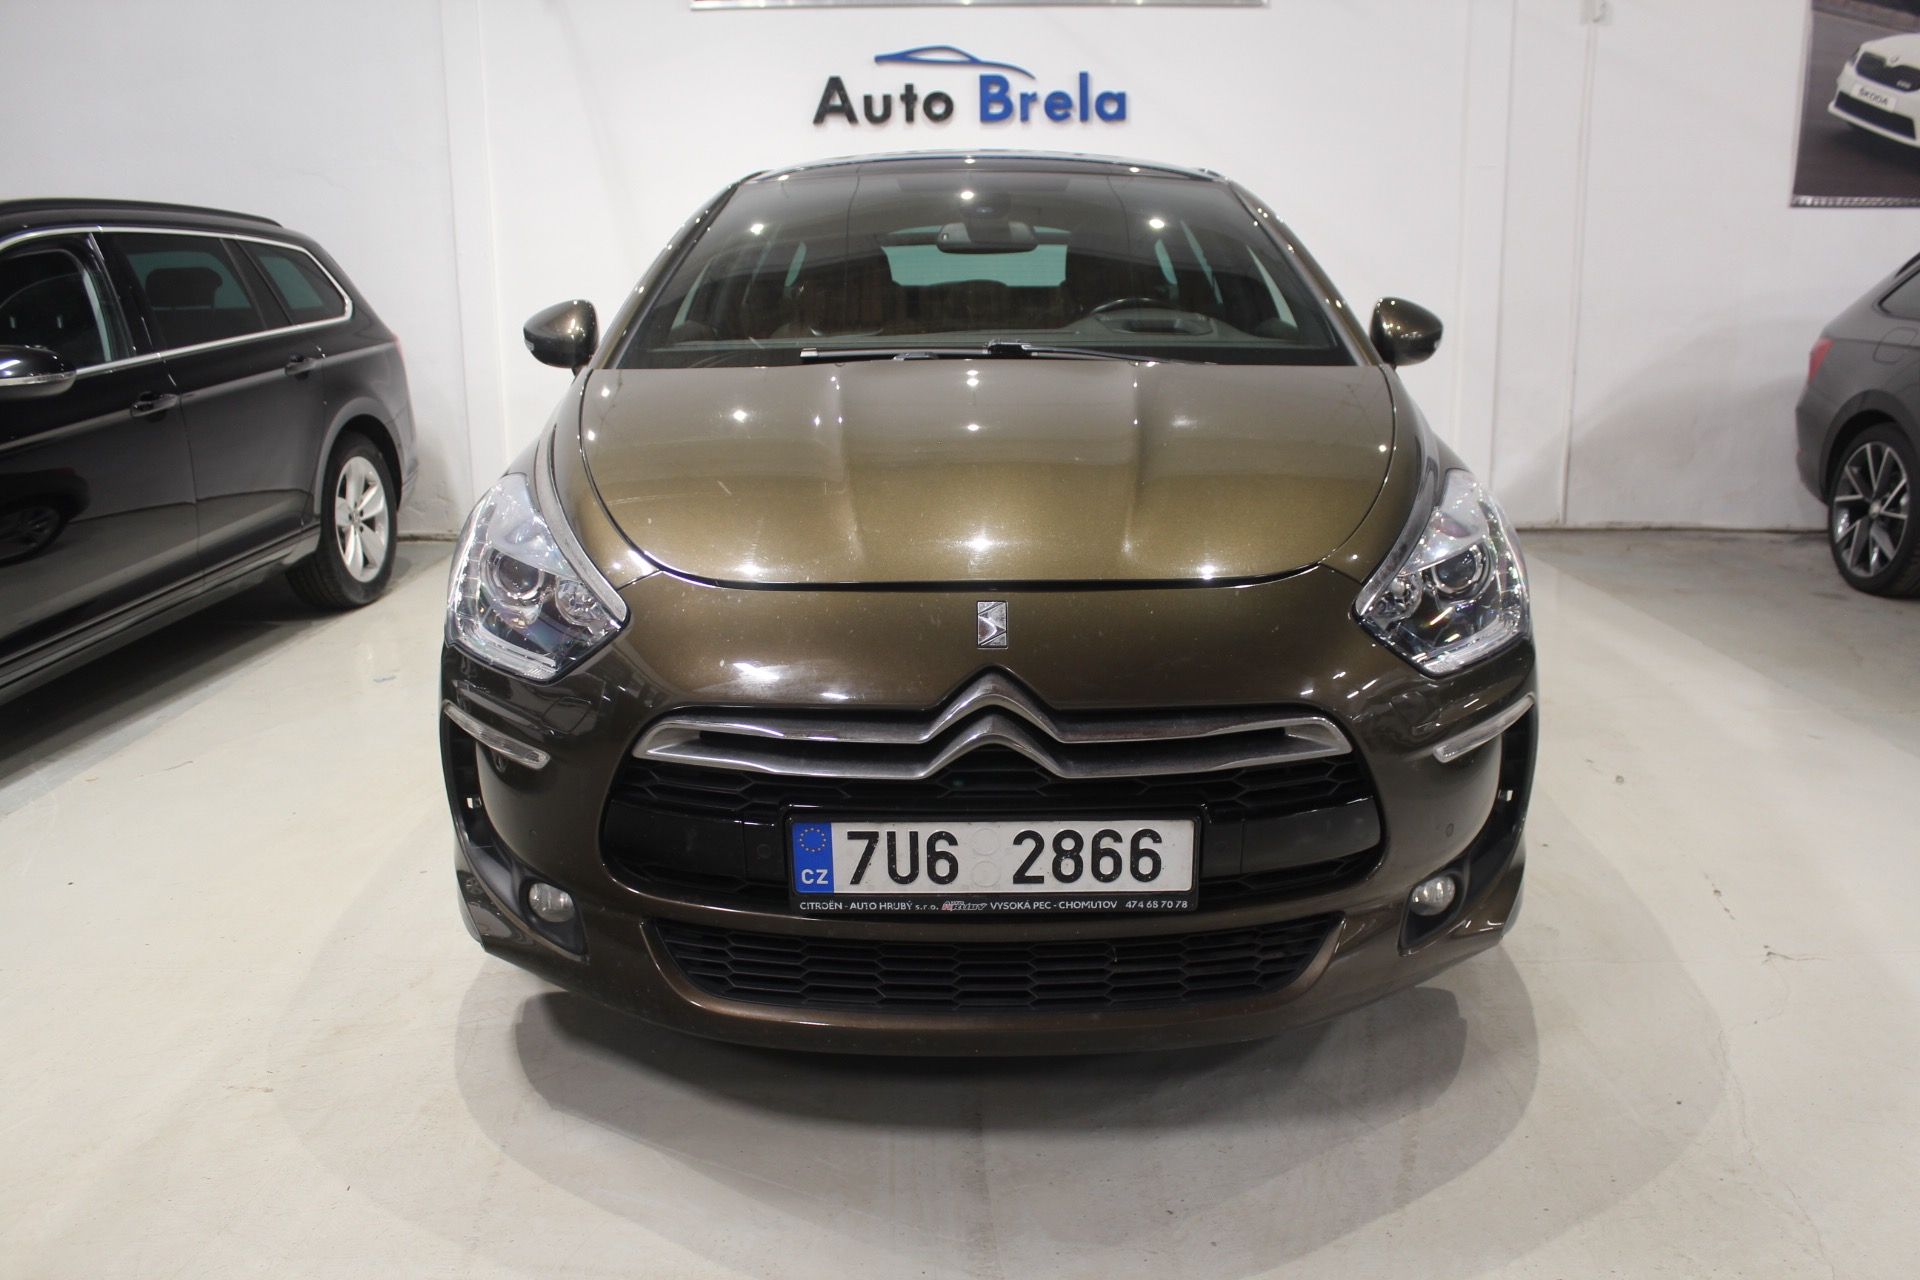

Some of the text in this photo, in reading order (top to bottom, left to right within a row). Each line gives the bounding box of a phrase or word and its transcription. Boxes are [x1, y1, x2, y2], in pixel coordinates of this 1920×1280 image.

[814, 72, 1127, 125] Auto Brela
[847, 829, 1162, 885] 7U6 2866
[801, 869, 829, 885] CZ
[800, 900, 843, 910] CITROËN
[850, 902, 877, 910] AUTO
[879, 900, 912, 910] HRUBÝ
[990, 899, 1031, 910] VYSOKÁ
[1033, 902, 1051, 910] PEC
[1059, 901, 1117, 909] CHOMUTOV
[1126, 901, 1144, 909] 474
[1161, 901, 1173, 909] 70
[1175, 901, 1188, 909] 78
